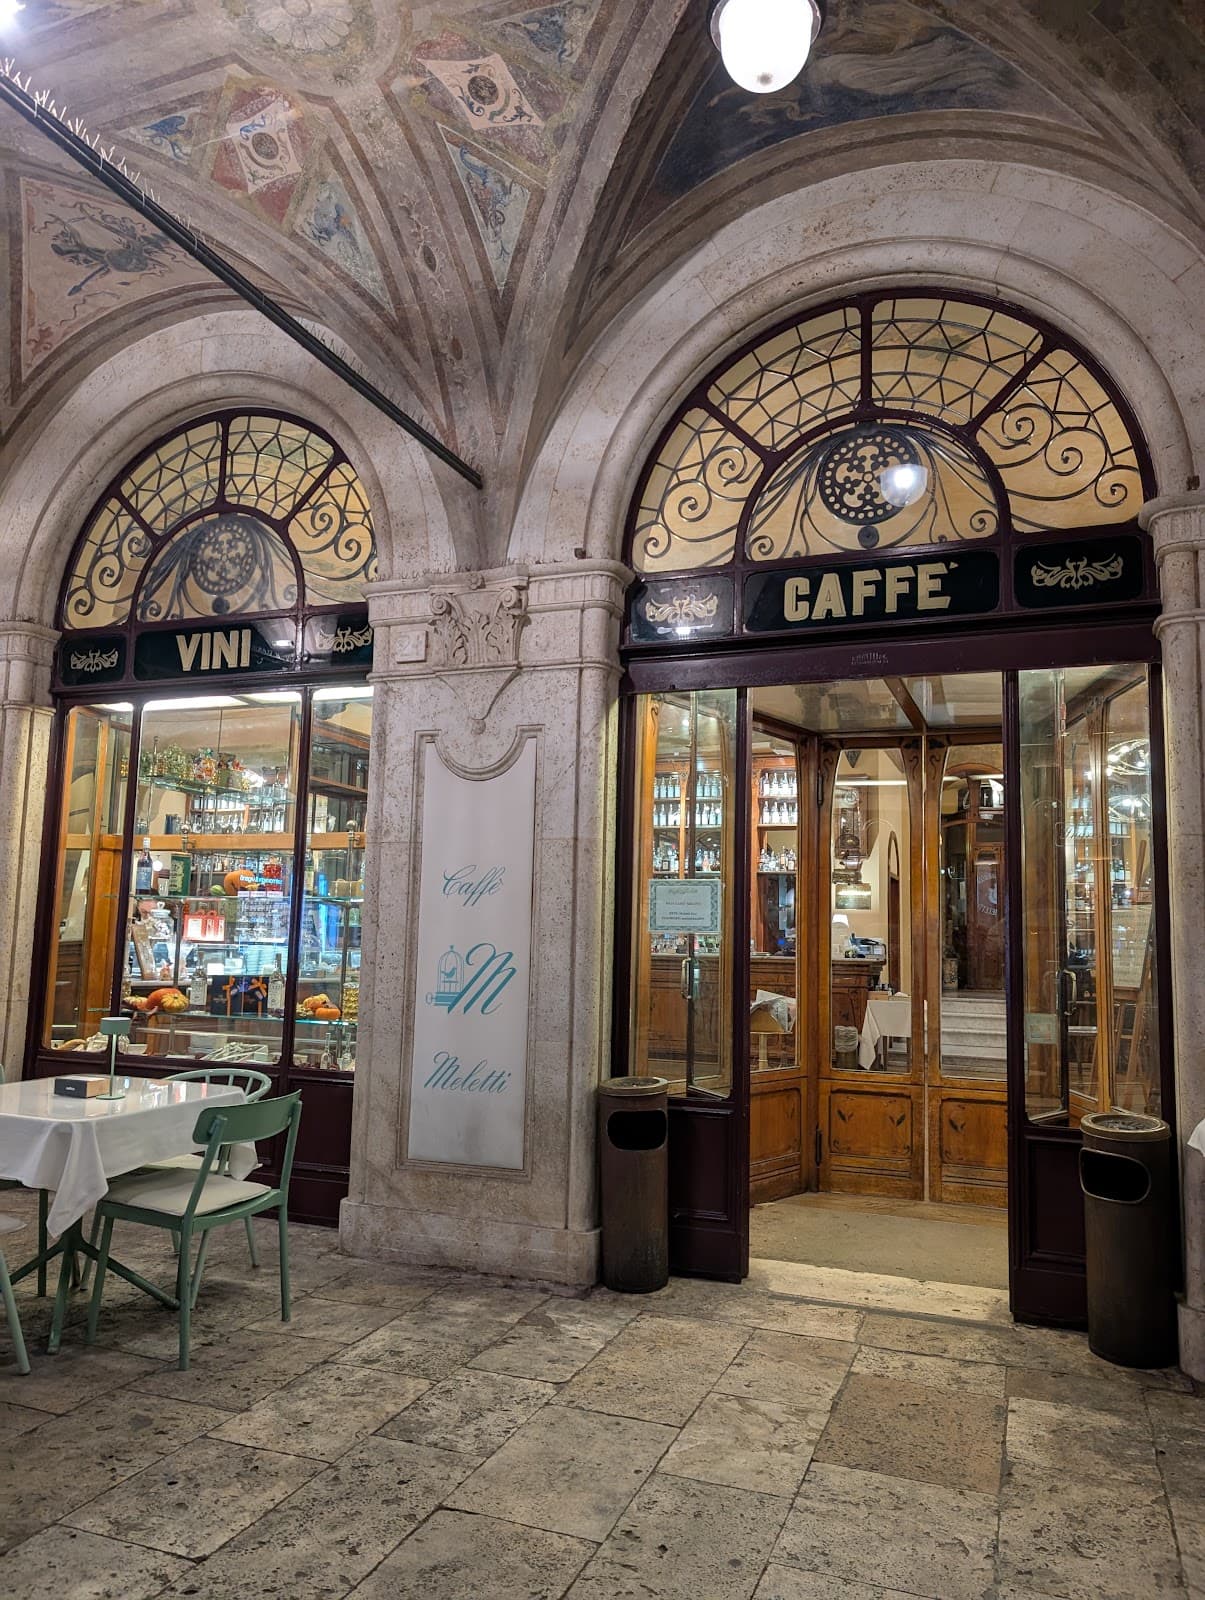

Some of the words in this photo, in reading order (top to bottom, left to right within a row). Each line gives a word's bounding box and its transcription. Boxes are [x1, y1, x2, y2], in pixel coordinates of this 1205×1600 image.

[175, 629, 252, 672] VINI
[442, 864, 506, 907] Caffè
[423, 1051, 512, 1093] Meletti
